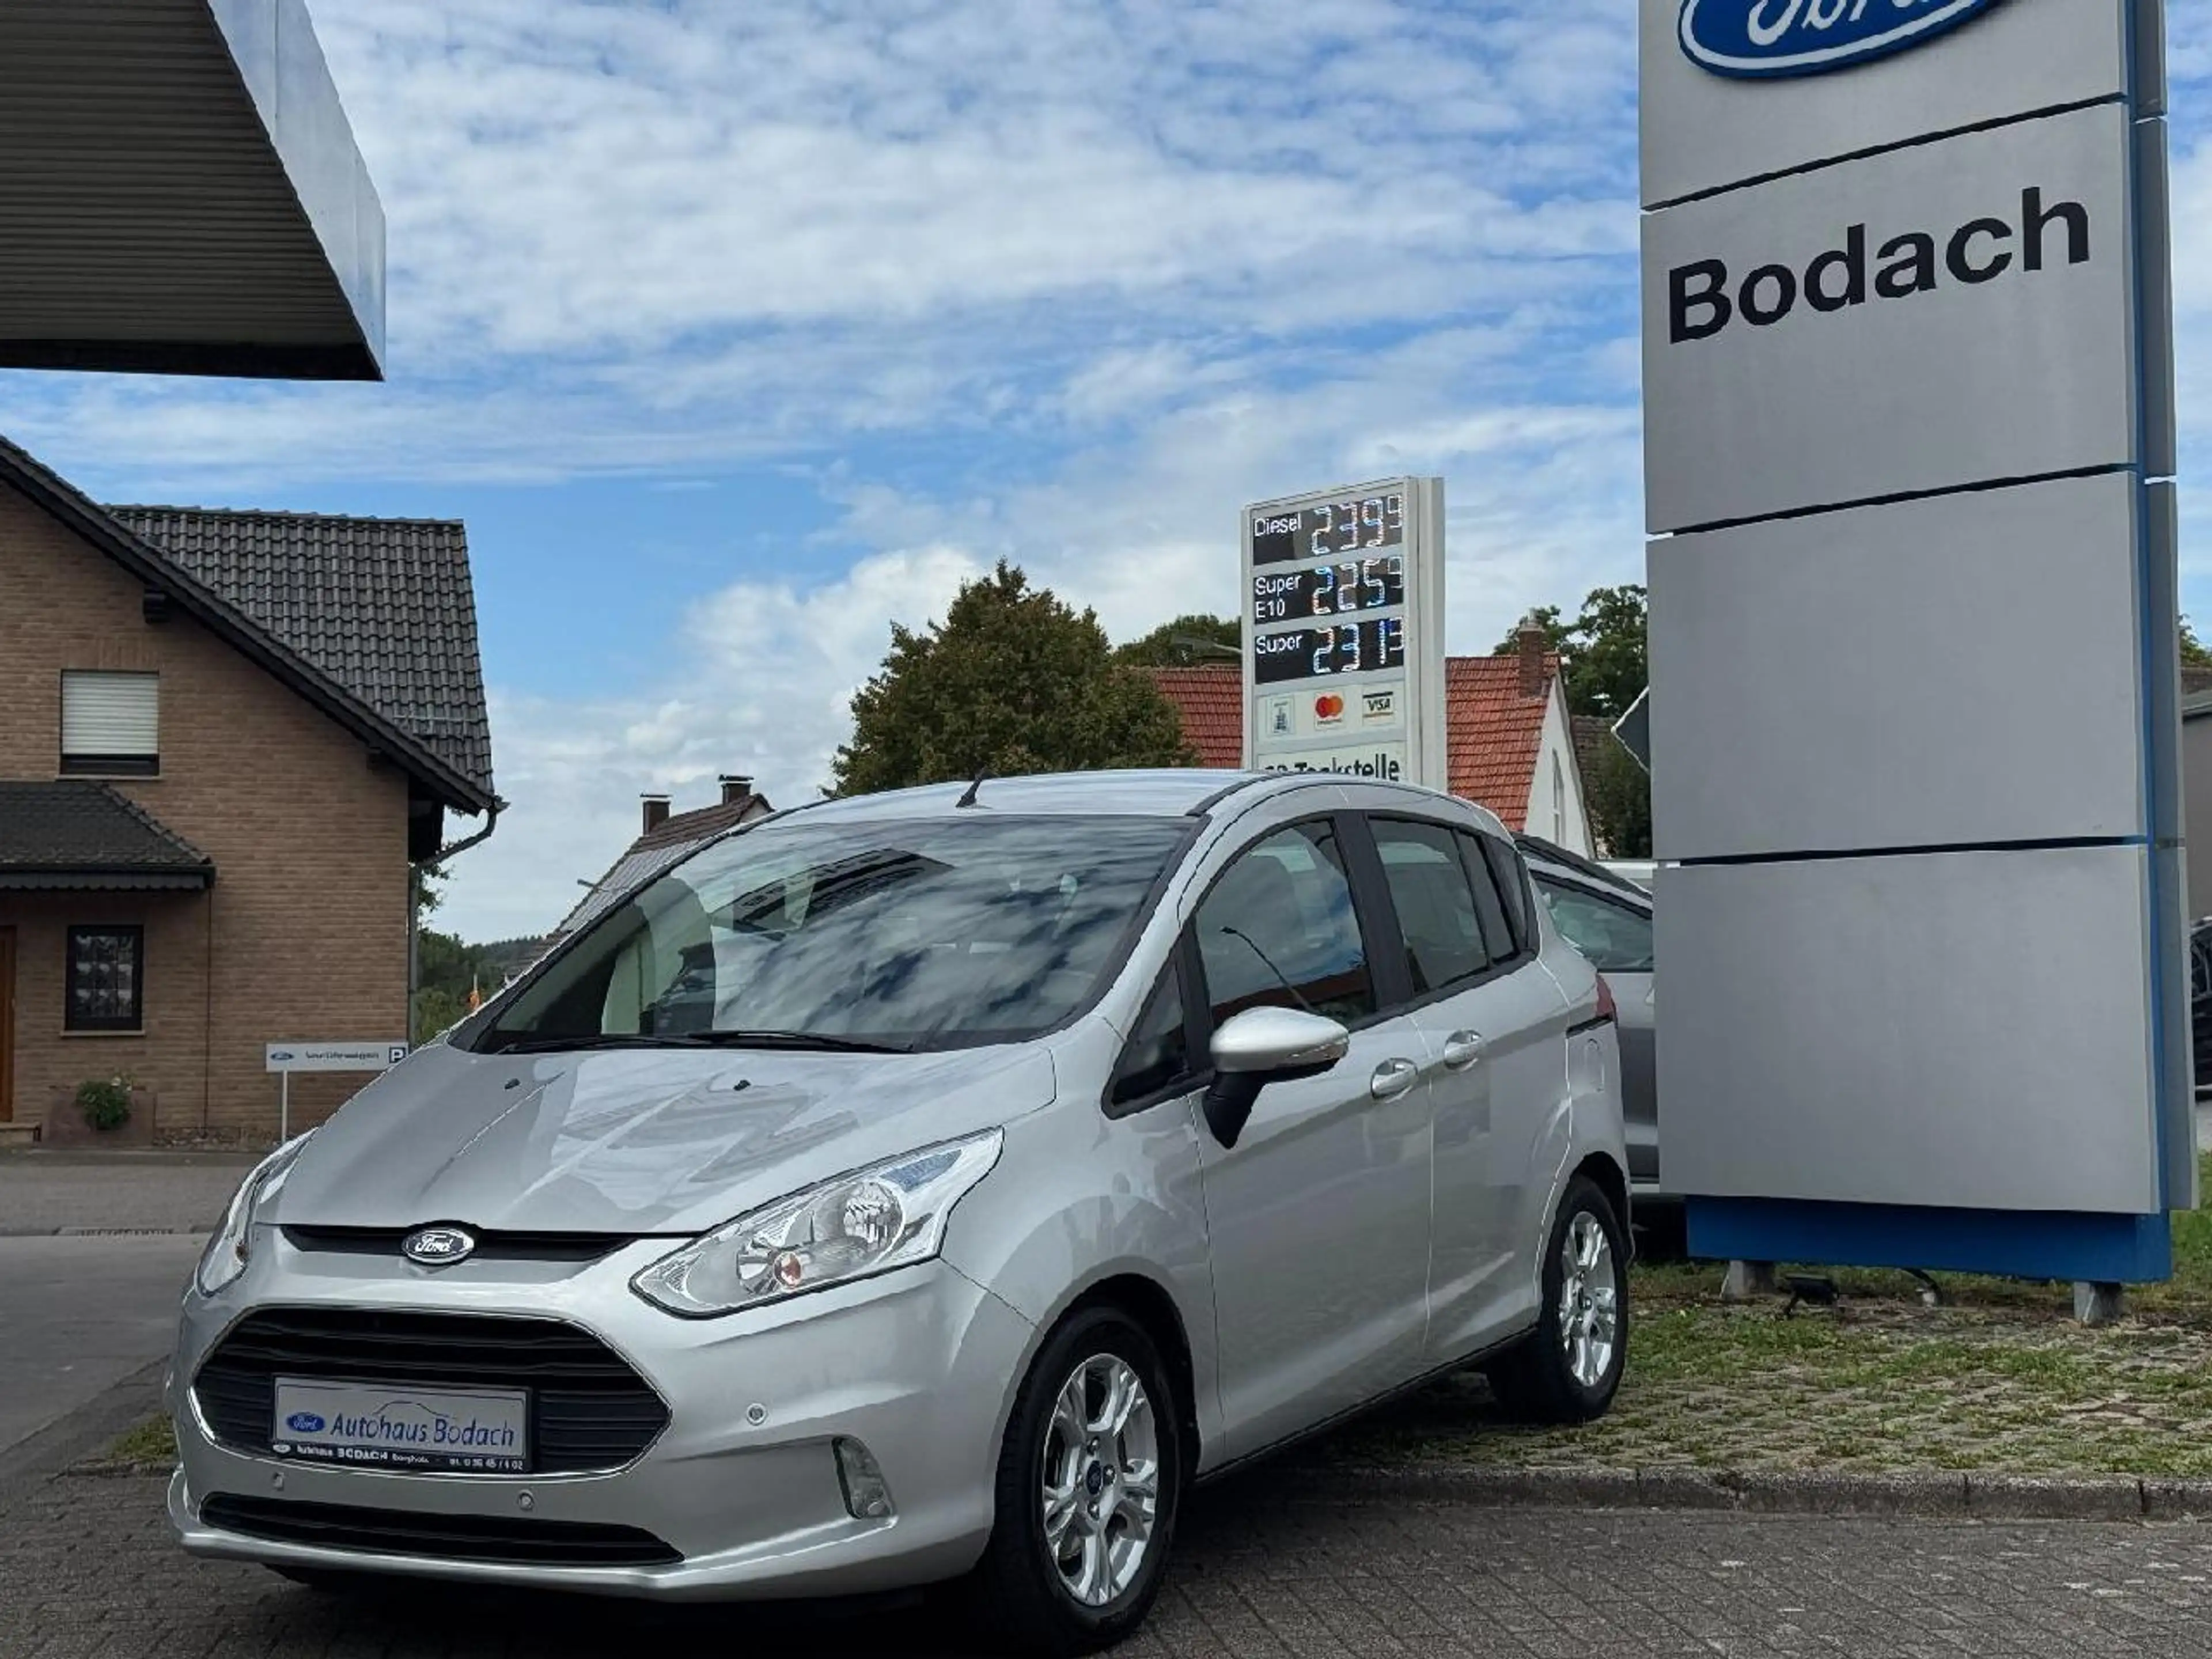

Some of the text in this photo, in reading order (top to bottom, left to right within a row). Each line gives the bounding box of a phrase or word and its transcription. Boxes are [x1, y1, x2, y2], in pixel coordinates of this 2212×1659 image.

[1669, 187, 2090, 344] Bodach
[1254, 512, 1302, 537] Diesel
[1255, 575, 1302, 597] Super
[1255, 597, 1286, 619] E10
[1255, 635, 1303, 655] Super
[1367, 698, 1391, 711] VISA
[391, 1049, 403, 1062] P
[414, 1234, 454, 1253] Ford
[329, 1412, 514, 1447] Autohaus Bodach
